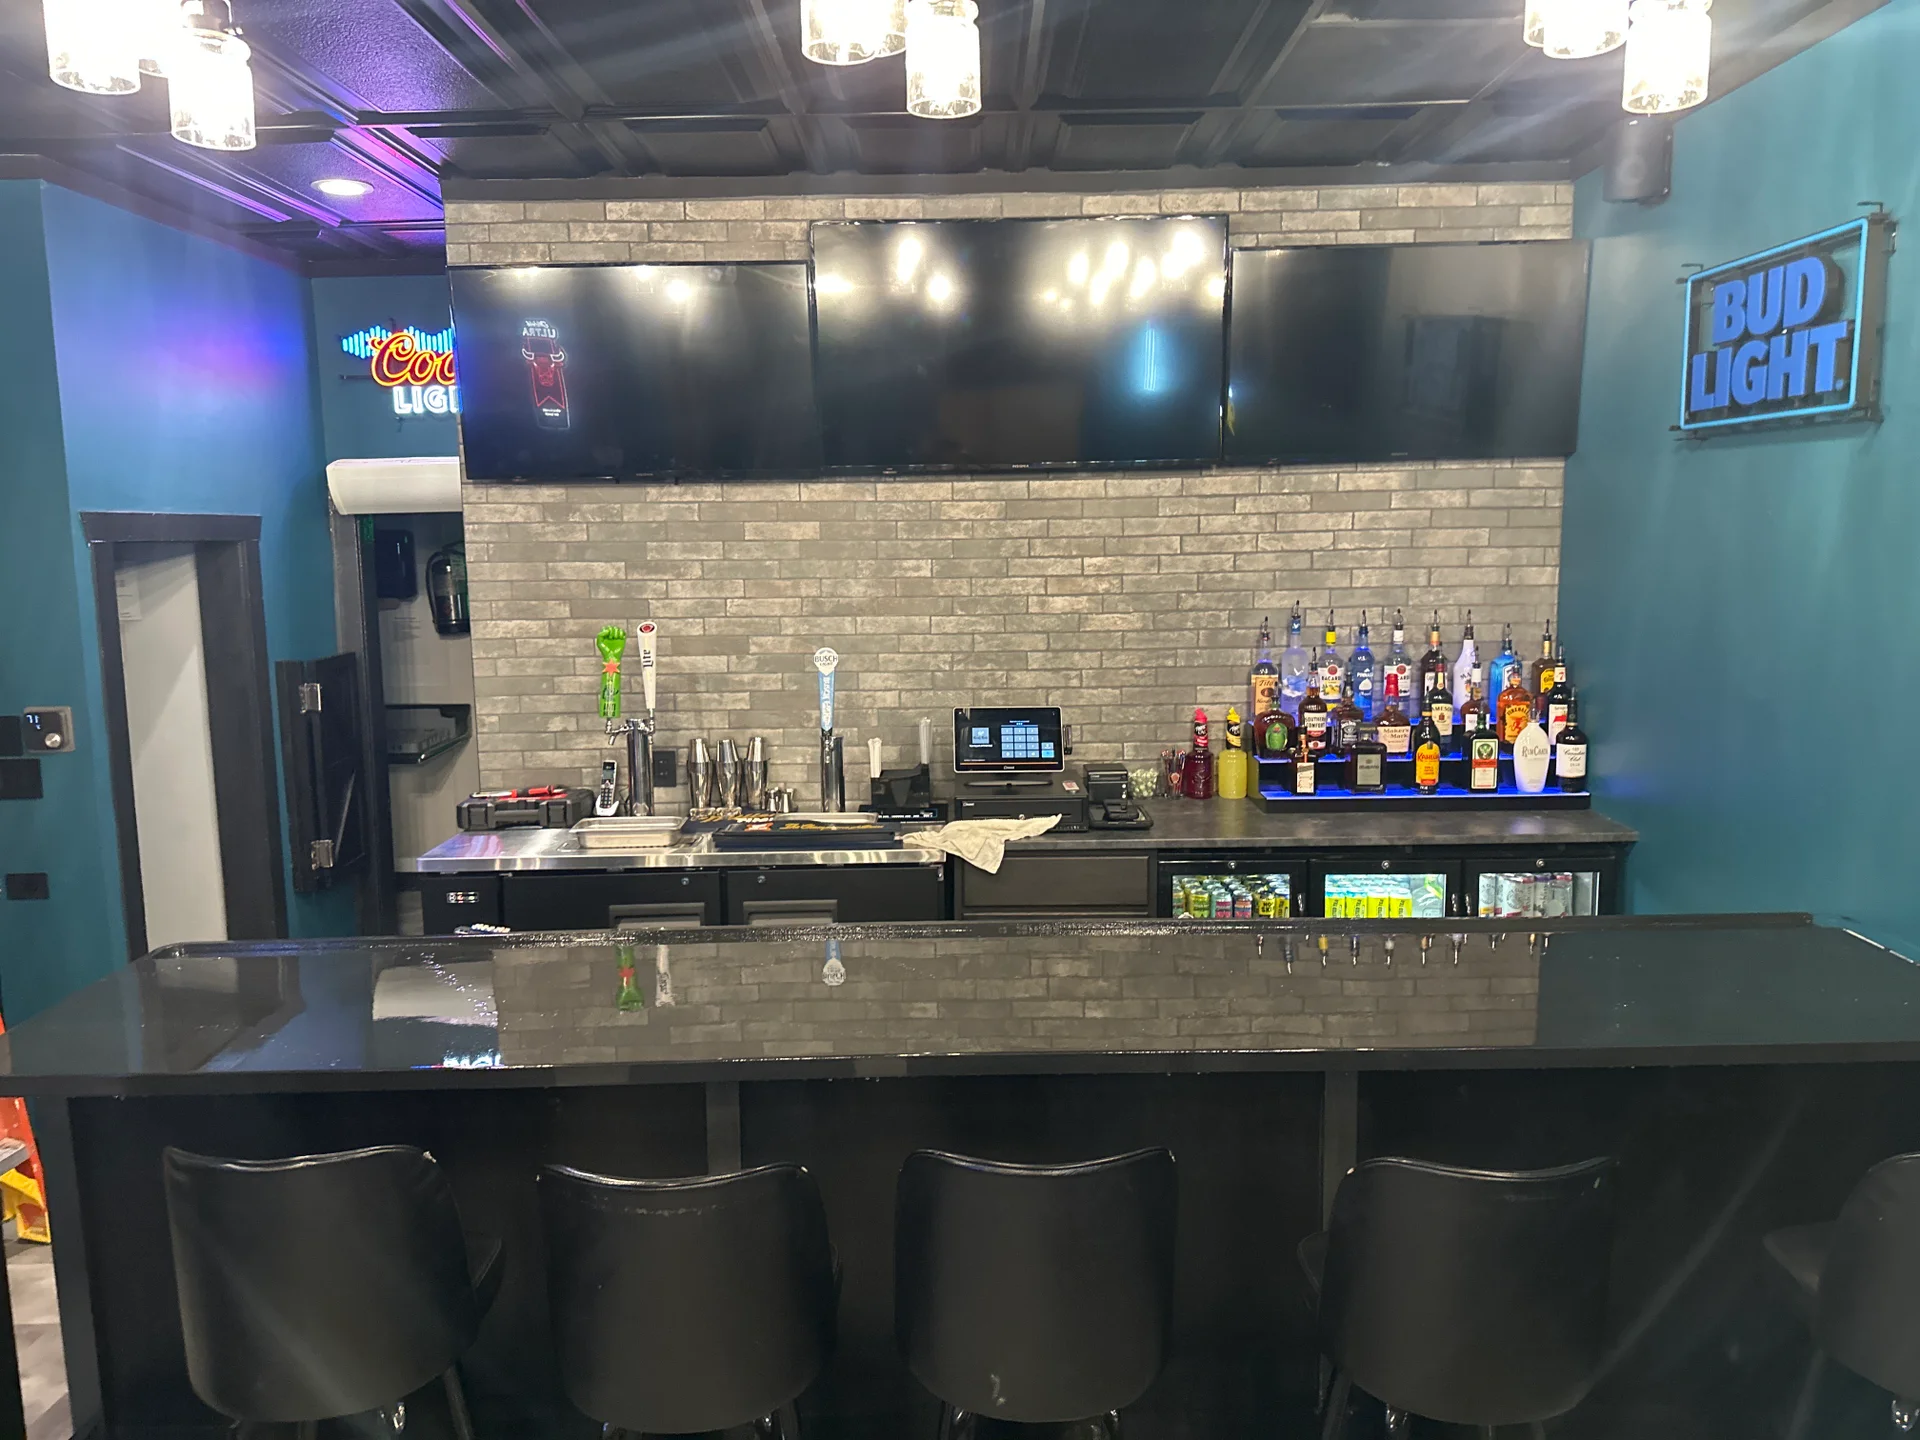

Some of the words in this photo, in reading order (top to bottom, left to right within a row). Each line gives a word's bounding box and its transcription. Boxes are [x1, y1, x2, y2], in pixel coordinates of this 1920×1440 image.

[1713, 256, 1825, 346] BUD
[371, 332, 455, 386] Coo
[1690, 320, 1848, 412] LIGHT
[393, 385, 459, 414] LIG
[643, 649, 653, 668] Lite
[814, 655, 838, 663] BUSCH
